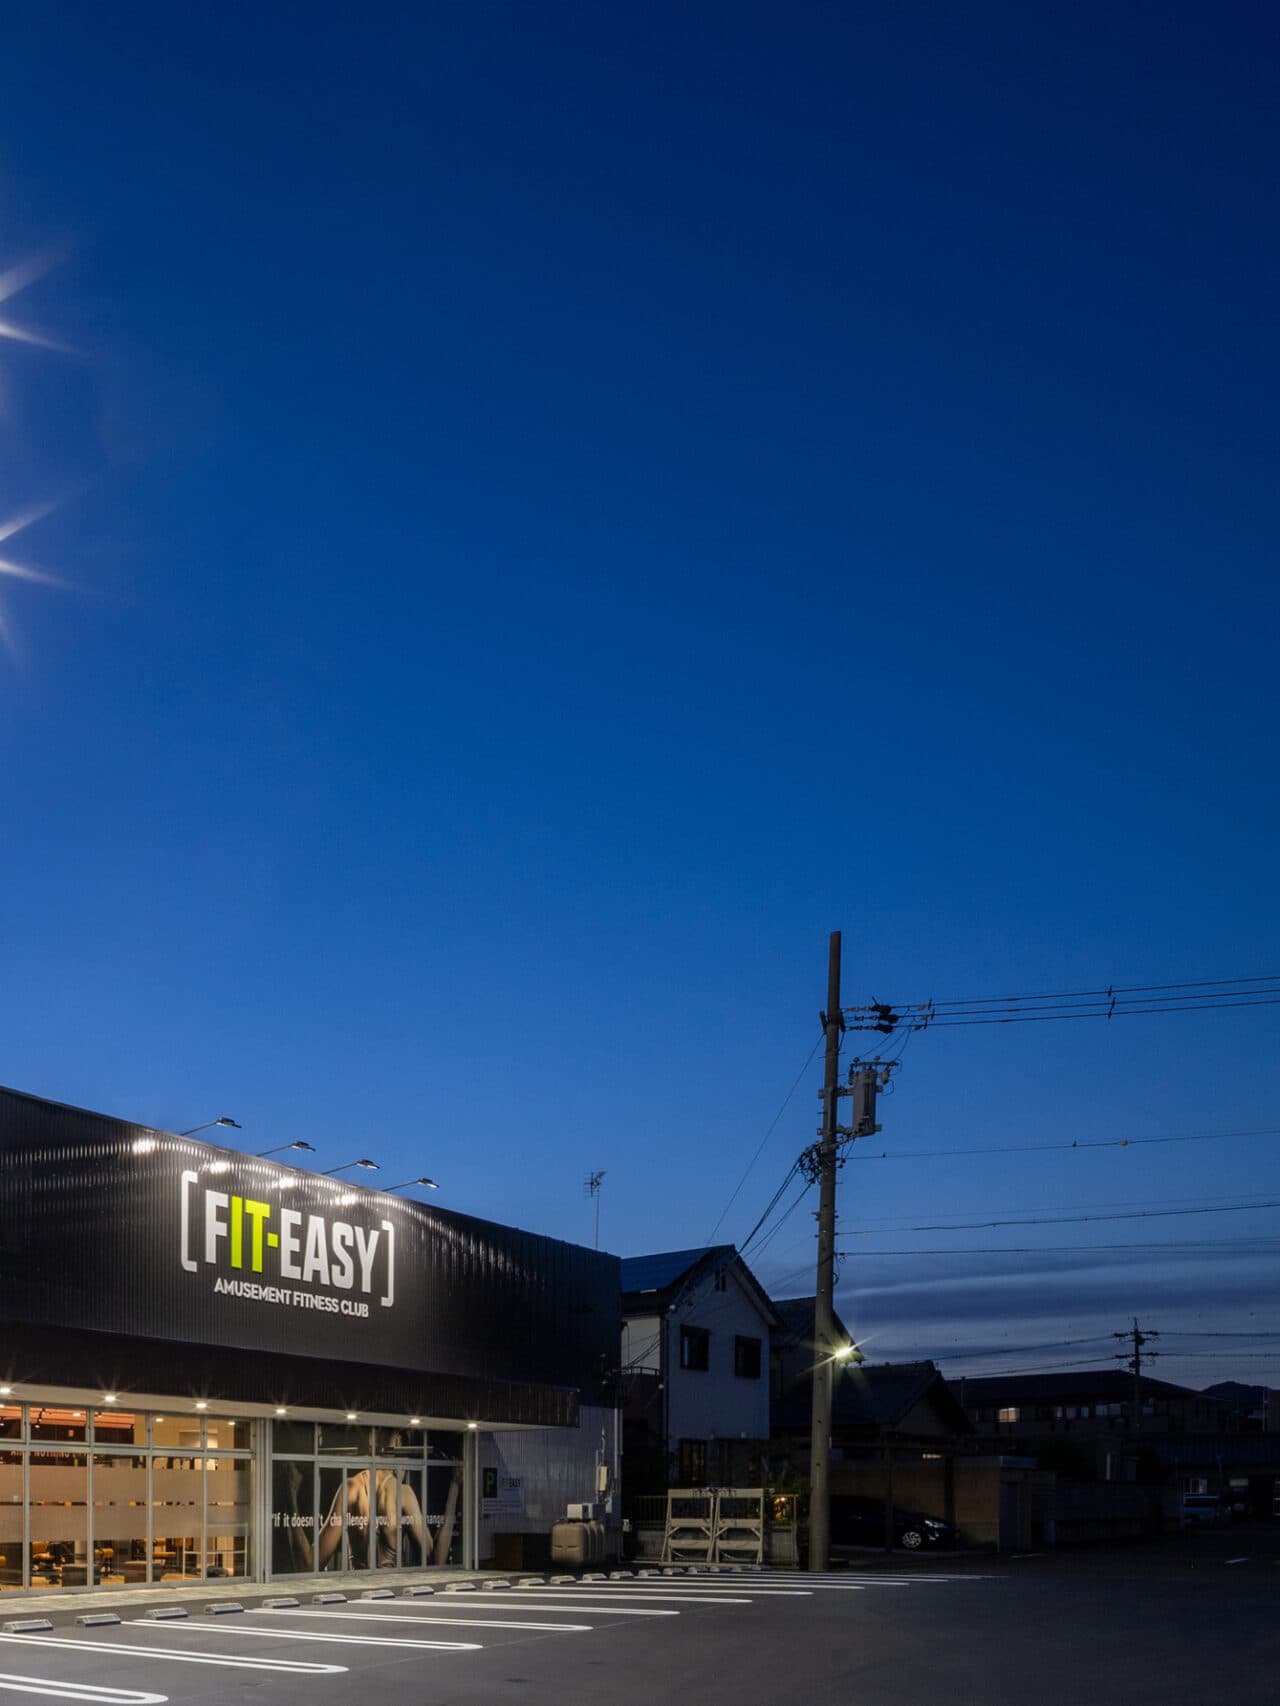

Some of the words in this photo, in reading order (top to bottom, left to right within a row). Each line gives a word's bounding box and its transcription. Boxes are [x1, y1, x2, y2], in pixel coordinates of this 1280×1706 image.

[214, 1277, 292, 1306] AMUSEMENT
[293, 1290, 339, 1314] FITNESS
[341, 1299, 369, 1318] CLUB
[283, 1512, 290, 1527] it
[291, 1512, 324, 1528] doesnt
